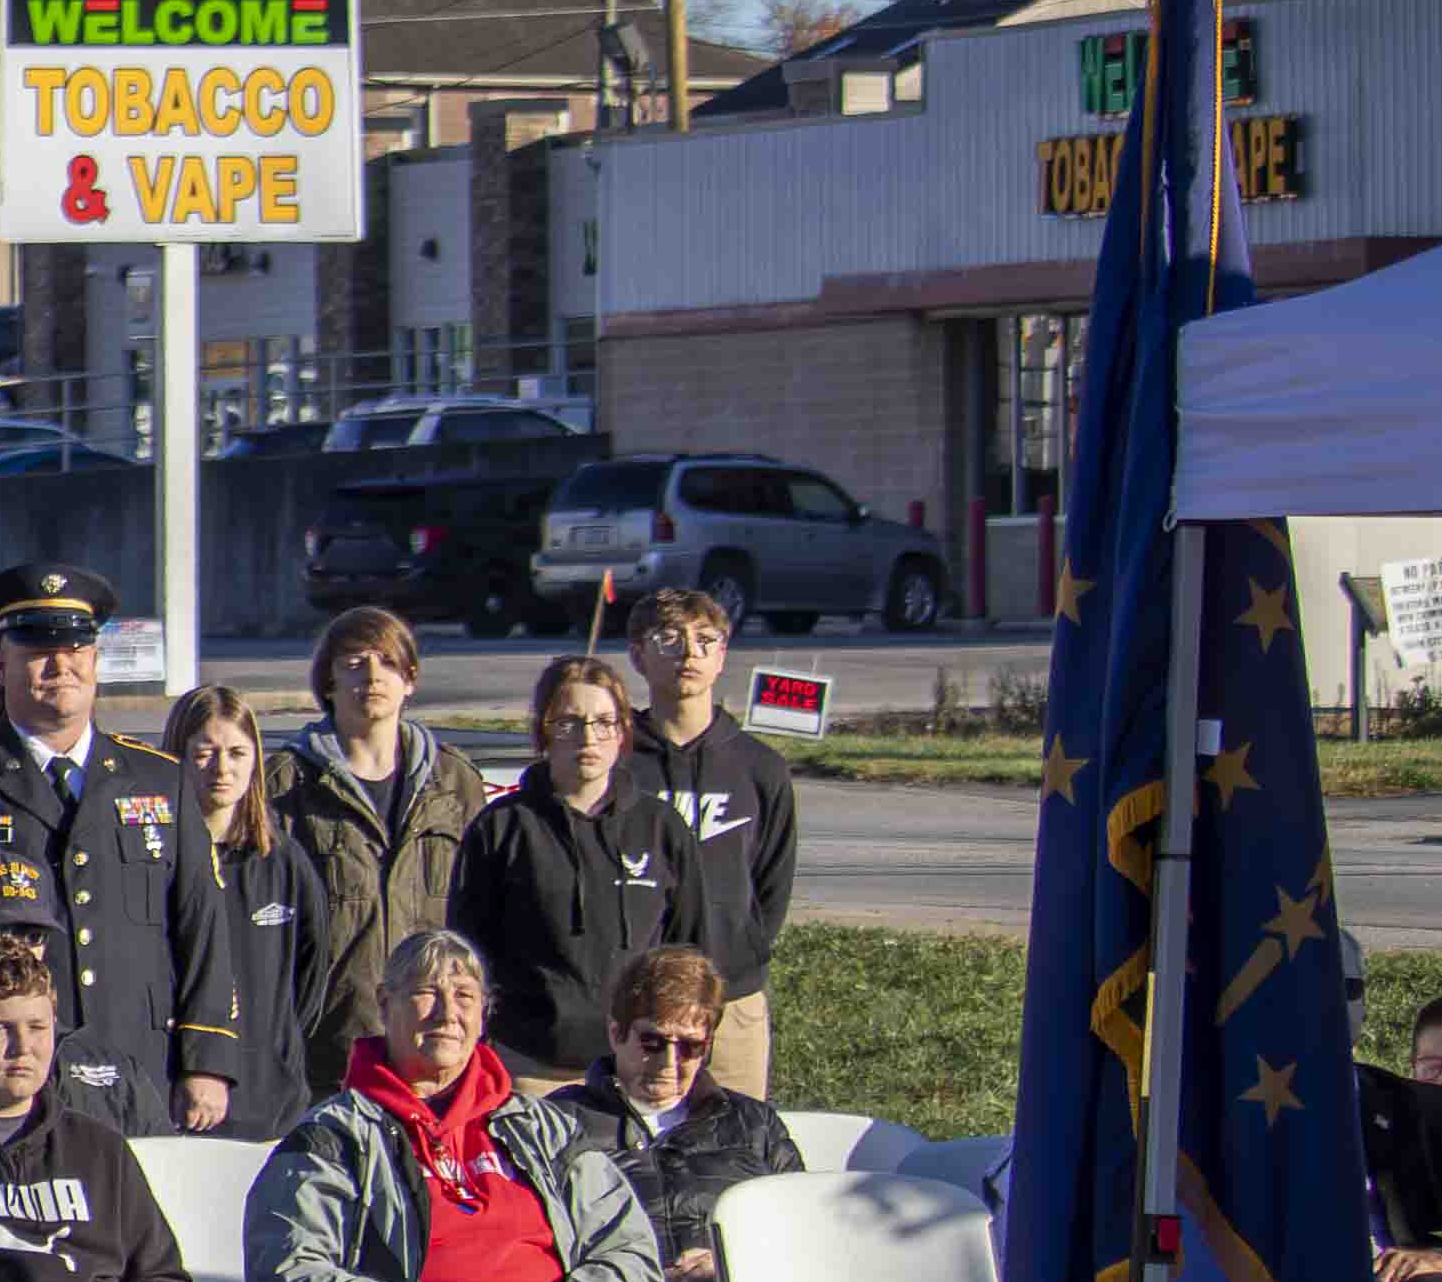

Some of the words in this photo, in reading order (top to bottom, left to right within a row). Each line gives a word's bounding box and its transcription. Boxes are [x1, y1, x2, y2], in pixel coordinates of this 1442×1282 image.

[24, 66, 336, 137] TOBACCO
[61, 154, 111, 224] &
[127, 155, 300, 224] VAPE
[761, 690, 818, 712] SALE
[767, 675, 819, 697] YARD
